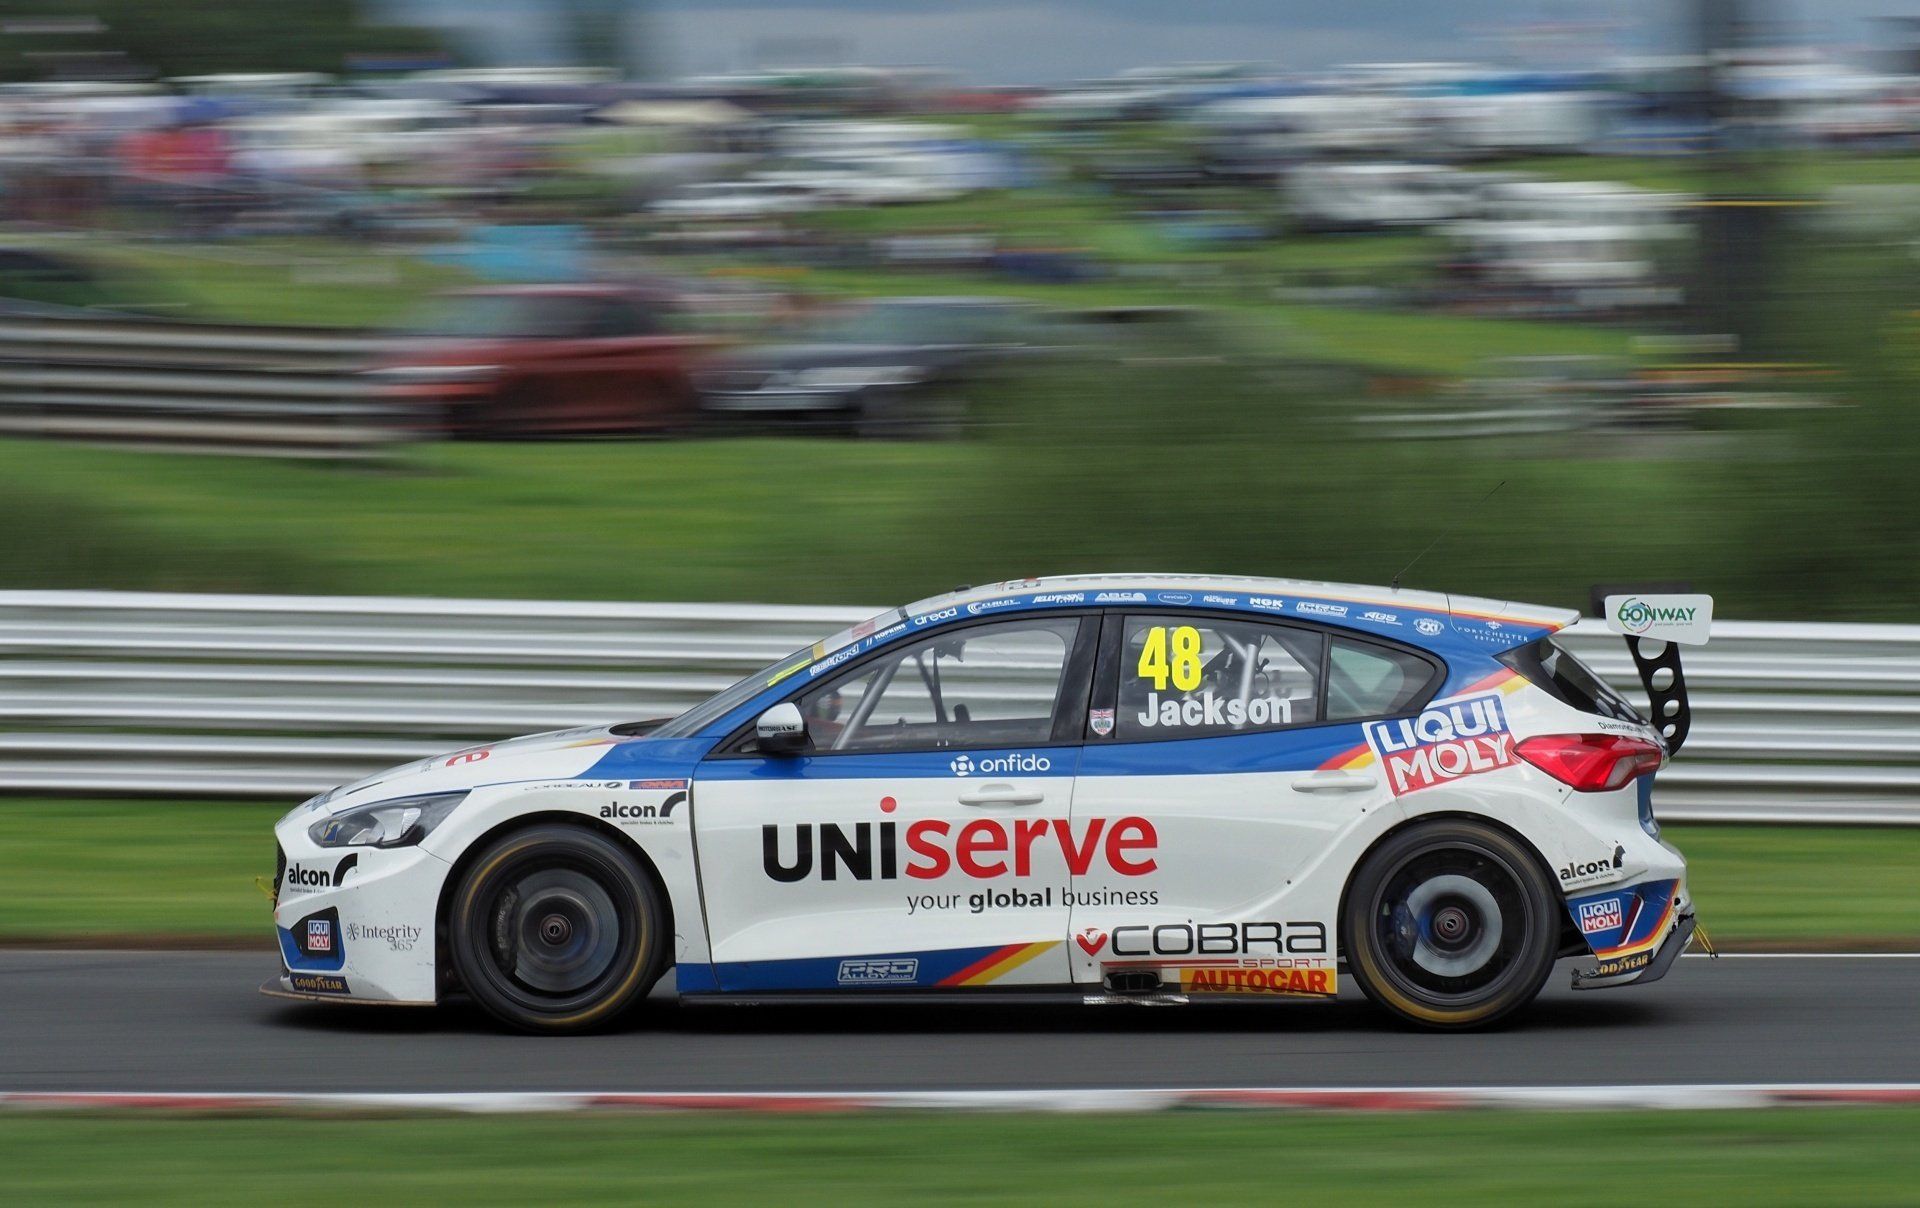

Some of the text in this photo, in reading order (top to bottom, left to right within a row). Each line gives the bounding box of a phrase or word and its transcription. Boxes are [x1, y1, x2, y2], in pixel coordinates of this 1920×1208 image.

[1250, 598, 1284, 608] NGK
[914, 607, 958, 626] dread
[1618, 608, 1697, 621] CONWAY
[874, 623, 907, 640] HOPKINS
[1137, 626, 1202, 691] 48
[1137, 692, 1291, 727] Jackson
[1377, 699, 1503, 752] LIQUI
[980, 754, 1051, 772] onfido
[1389, 734, 1510, 792] MOLY
[600, 801, 656, 818] alcon
[288, 862, 330, 887] alcon
[1560, 858, 1610, 881] alcon
[906, 886, 1159, 915] your global business
[1582, 901, 1618, 917] LIQUI
[310, 923, 329, 935] LIQUI
[1584, 913, 1621, 931] MOLY
[309, 936, 330, 948] MOLY
[362, 924, 422, 942] Integrity
[1111, 921, 1327, 956] COBRA
[390, 940, 413, 951] 365
[1242, 958, 1327, 968] SPORT
[295, 976, 343, 990] GOODYEAR
[1188, 969, 1328, 993] AUTOCAR
